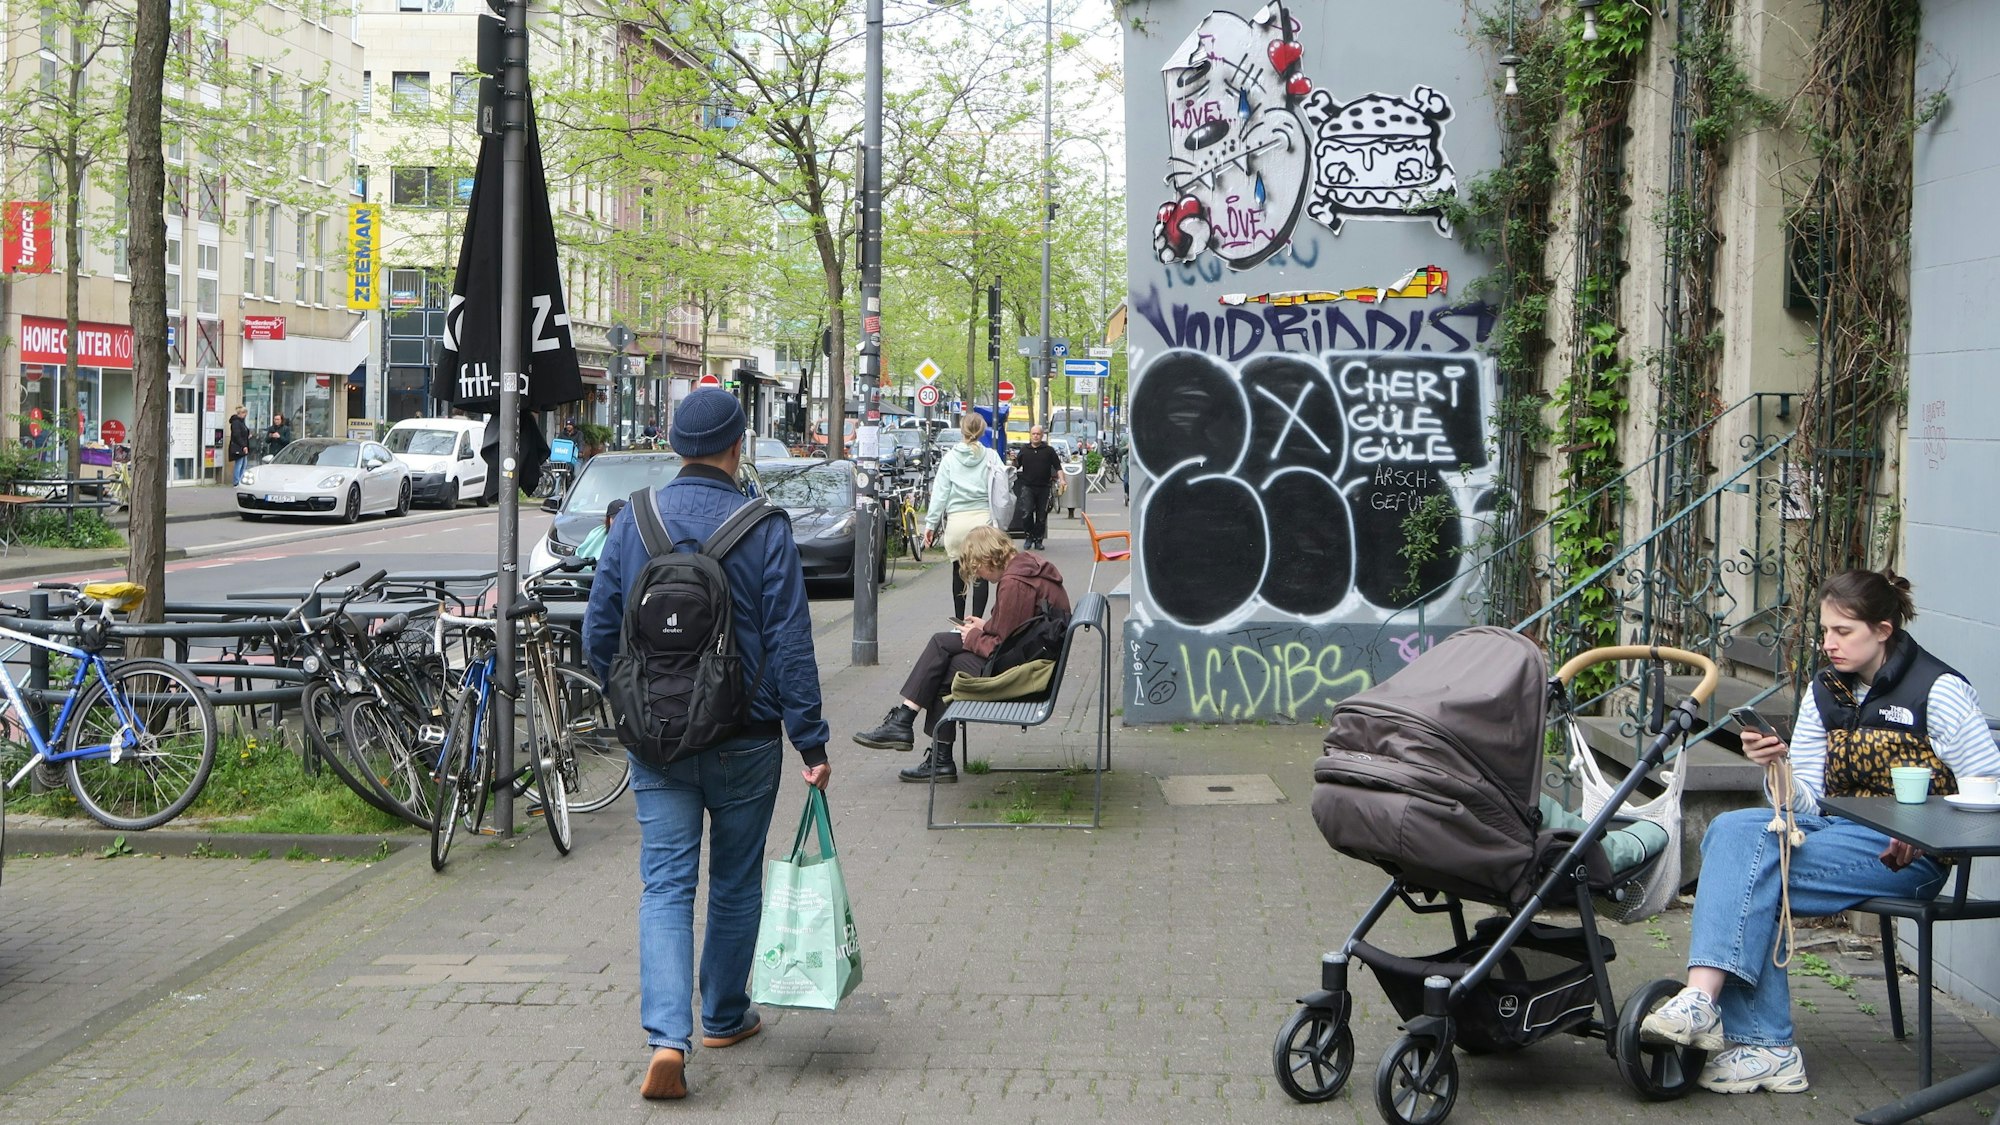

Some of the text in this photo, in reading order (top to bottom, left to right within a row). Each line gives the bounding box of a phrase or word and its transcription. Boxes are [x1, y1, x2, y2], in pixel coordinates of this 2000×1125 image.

[18, 208, 37, 266] tipico
[355, 209, 371, 302] ZEEMAN
[23, 325, 111, 358] HOMECNTER
[922, 391, 934, 401] 30
[1347, 404, 1443, 435] GÜLE
[1352, 436, 1456, 463] GÜLE
[1879, 708, 1902, 718] NORTH
[1885, 715, 1902, 723] FACE
